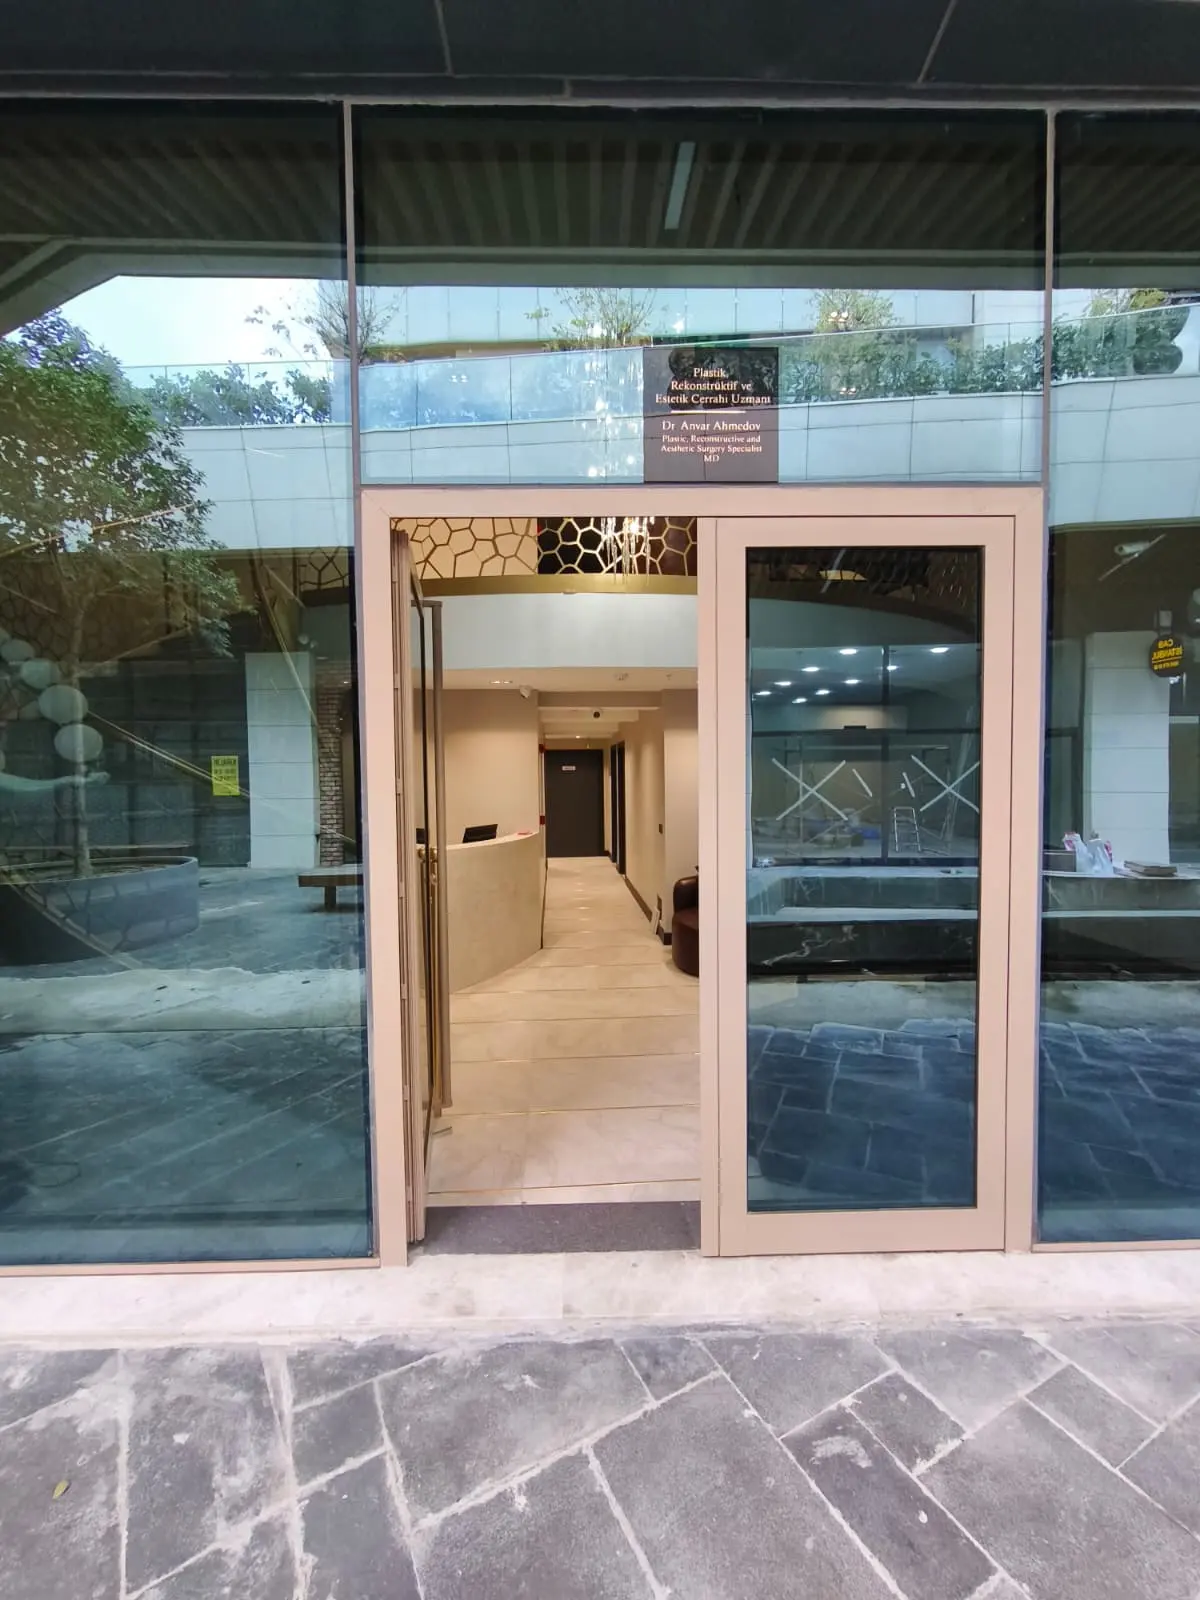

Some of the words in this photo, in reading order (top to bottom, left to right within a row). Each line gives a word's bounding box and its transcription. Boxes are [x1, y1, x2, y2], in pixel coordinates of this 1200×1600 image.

[693, 367, 729, 378] Plastik,
[671, 380, 738, 391] Rekonstrüktif
[741, 383, 753, 391] ve
[655, 394, 689, 404] Estetik
[731, 394, 771, 404] Uzmanı
[681, 421, 710, 430] Anvar
[713, 420, 761, 430] Ahmedov
[661, 444, 695, 452] Aesthetic
[697, 445, 725, 453] Surgery
[727, 444, 762, 453] Specialist
[704, 454, 720, 462] MD
